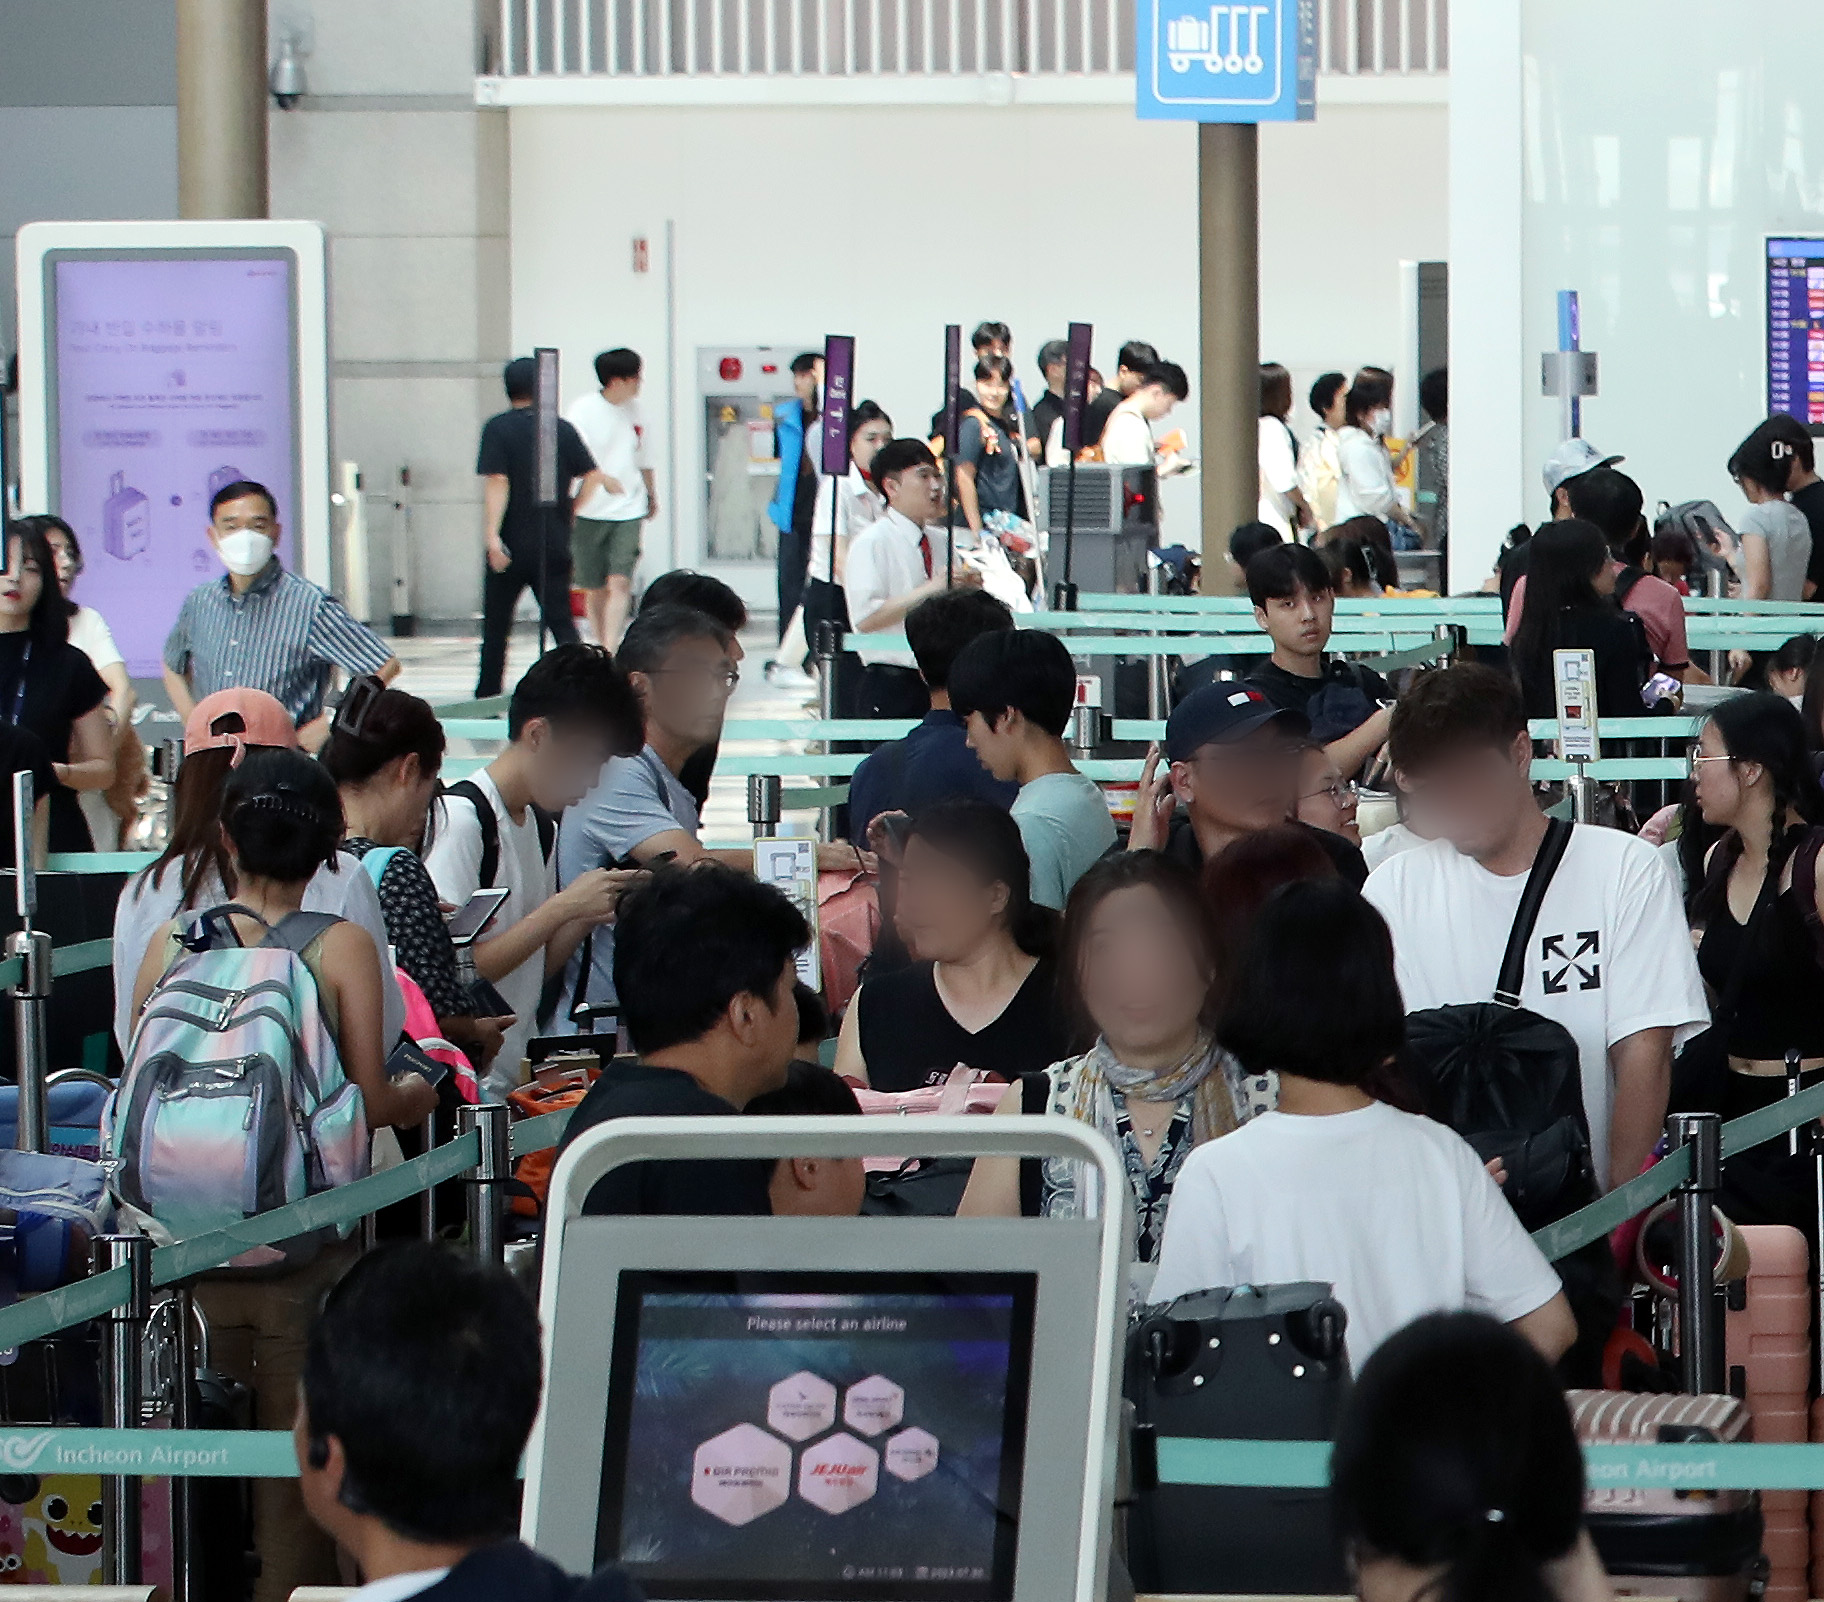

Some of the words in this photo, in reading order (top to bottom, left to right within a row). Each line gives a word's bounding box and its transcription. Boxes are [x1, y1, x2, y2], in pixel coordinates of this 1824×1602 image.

[746, 1316, 793, 1331] Please
[795, 1316, 837, 1331] select
[842, 1319, 859, 1331] an
[863, 1316, 907, 1332] airline
[56, 1445, 142, 1464] Incheon
[151, 1445, 229, 1468] Airport
[1635, 1459, 1716, 1481] Airport
